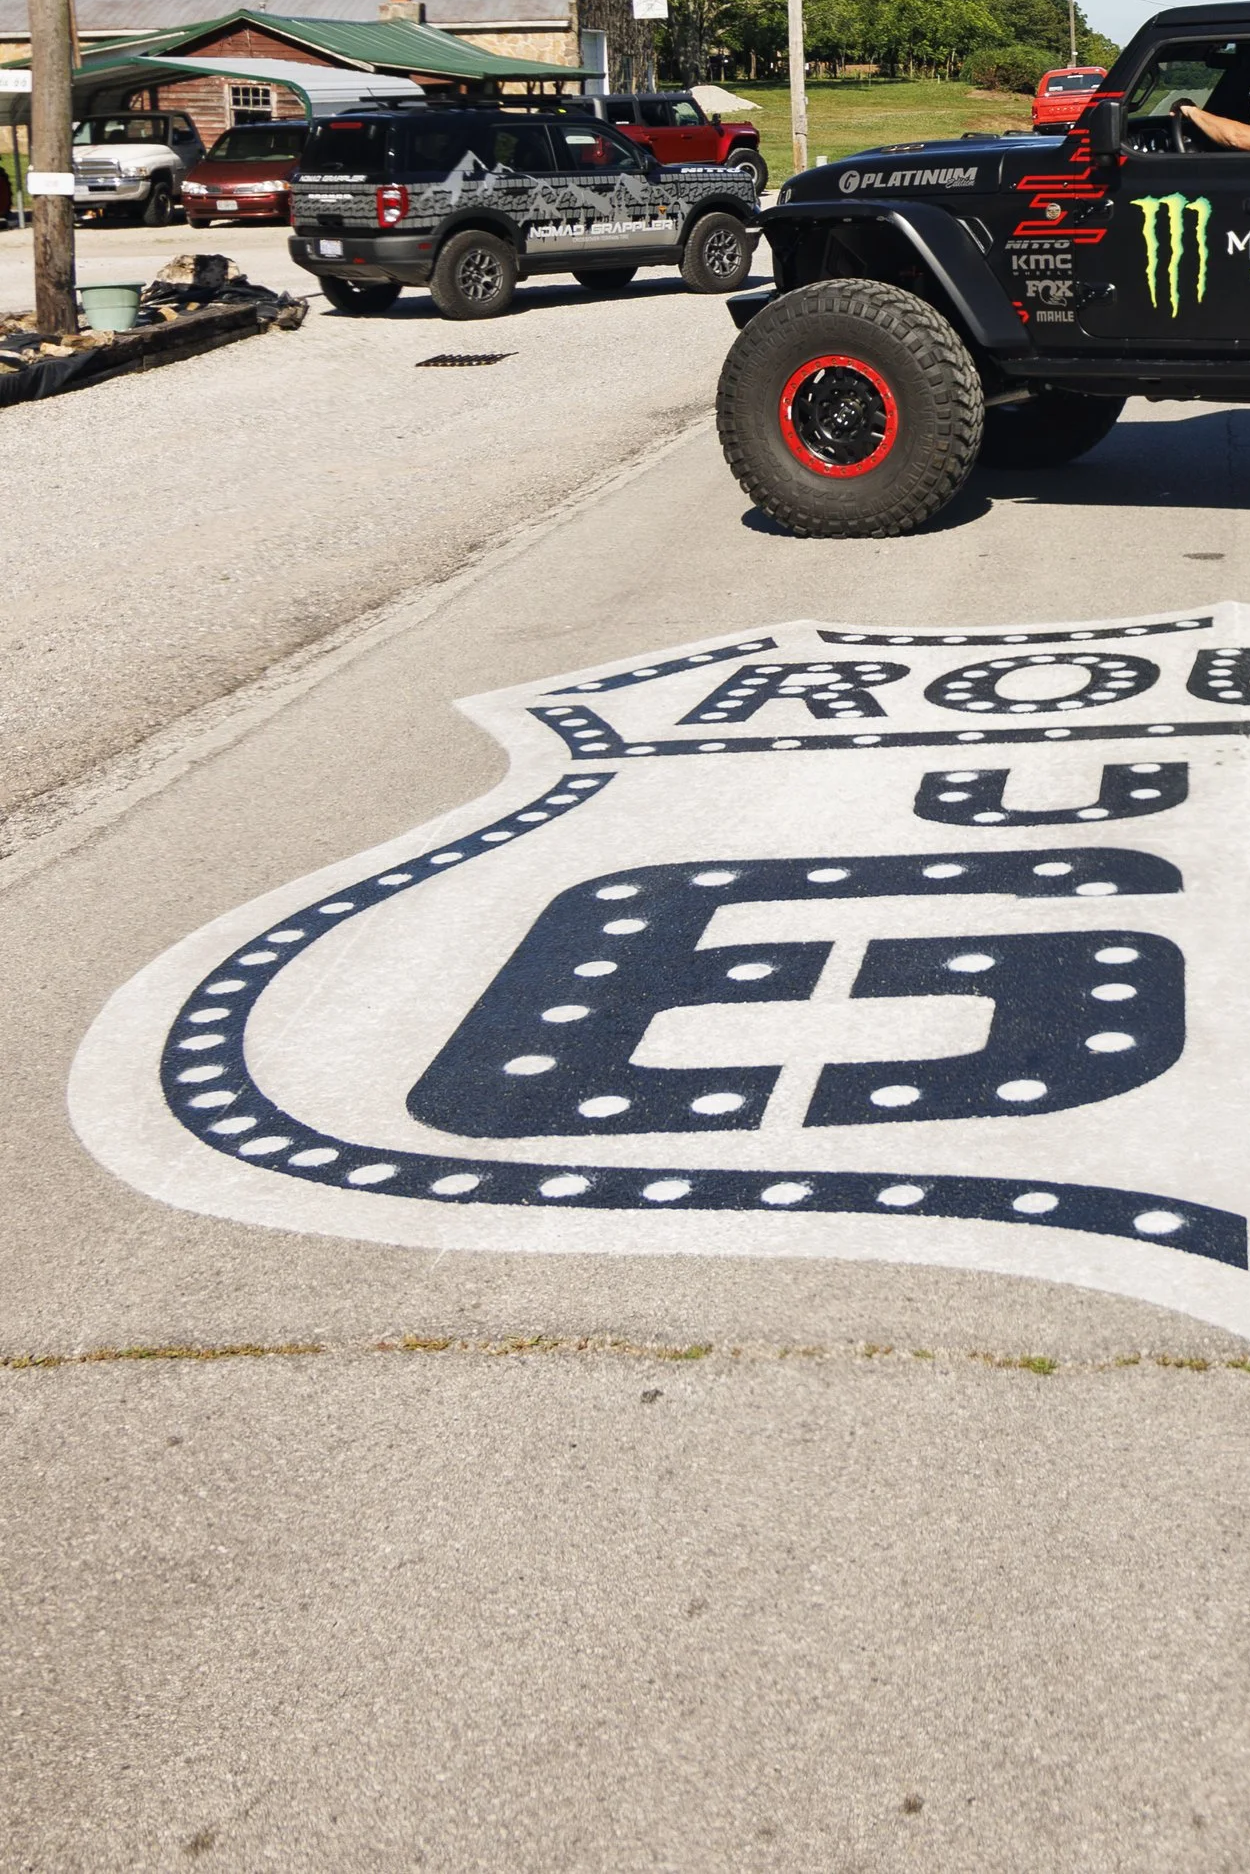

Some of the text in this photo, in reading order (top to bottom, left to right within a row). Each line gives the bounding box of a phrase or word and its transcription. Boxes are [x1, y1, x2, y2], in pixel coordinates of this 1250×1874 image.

[860, 166, 979, 189] PLATINUM
[529, 219, 675, 239] NOMAD GRAPPLER
[1005, 239, 1070, 249] NITTO
[1025, 279, 1074, 302] FOX
[1036, 310, 1075, 323] MAHLE
